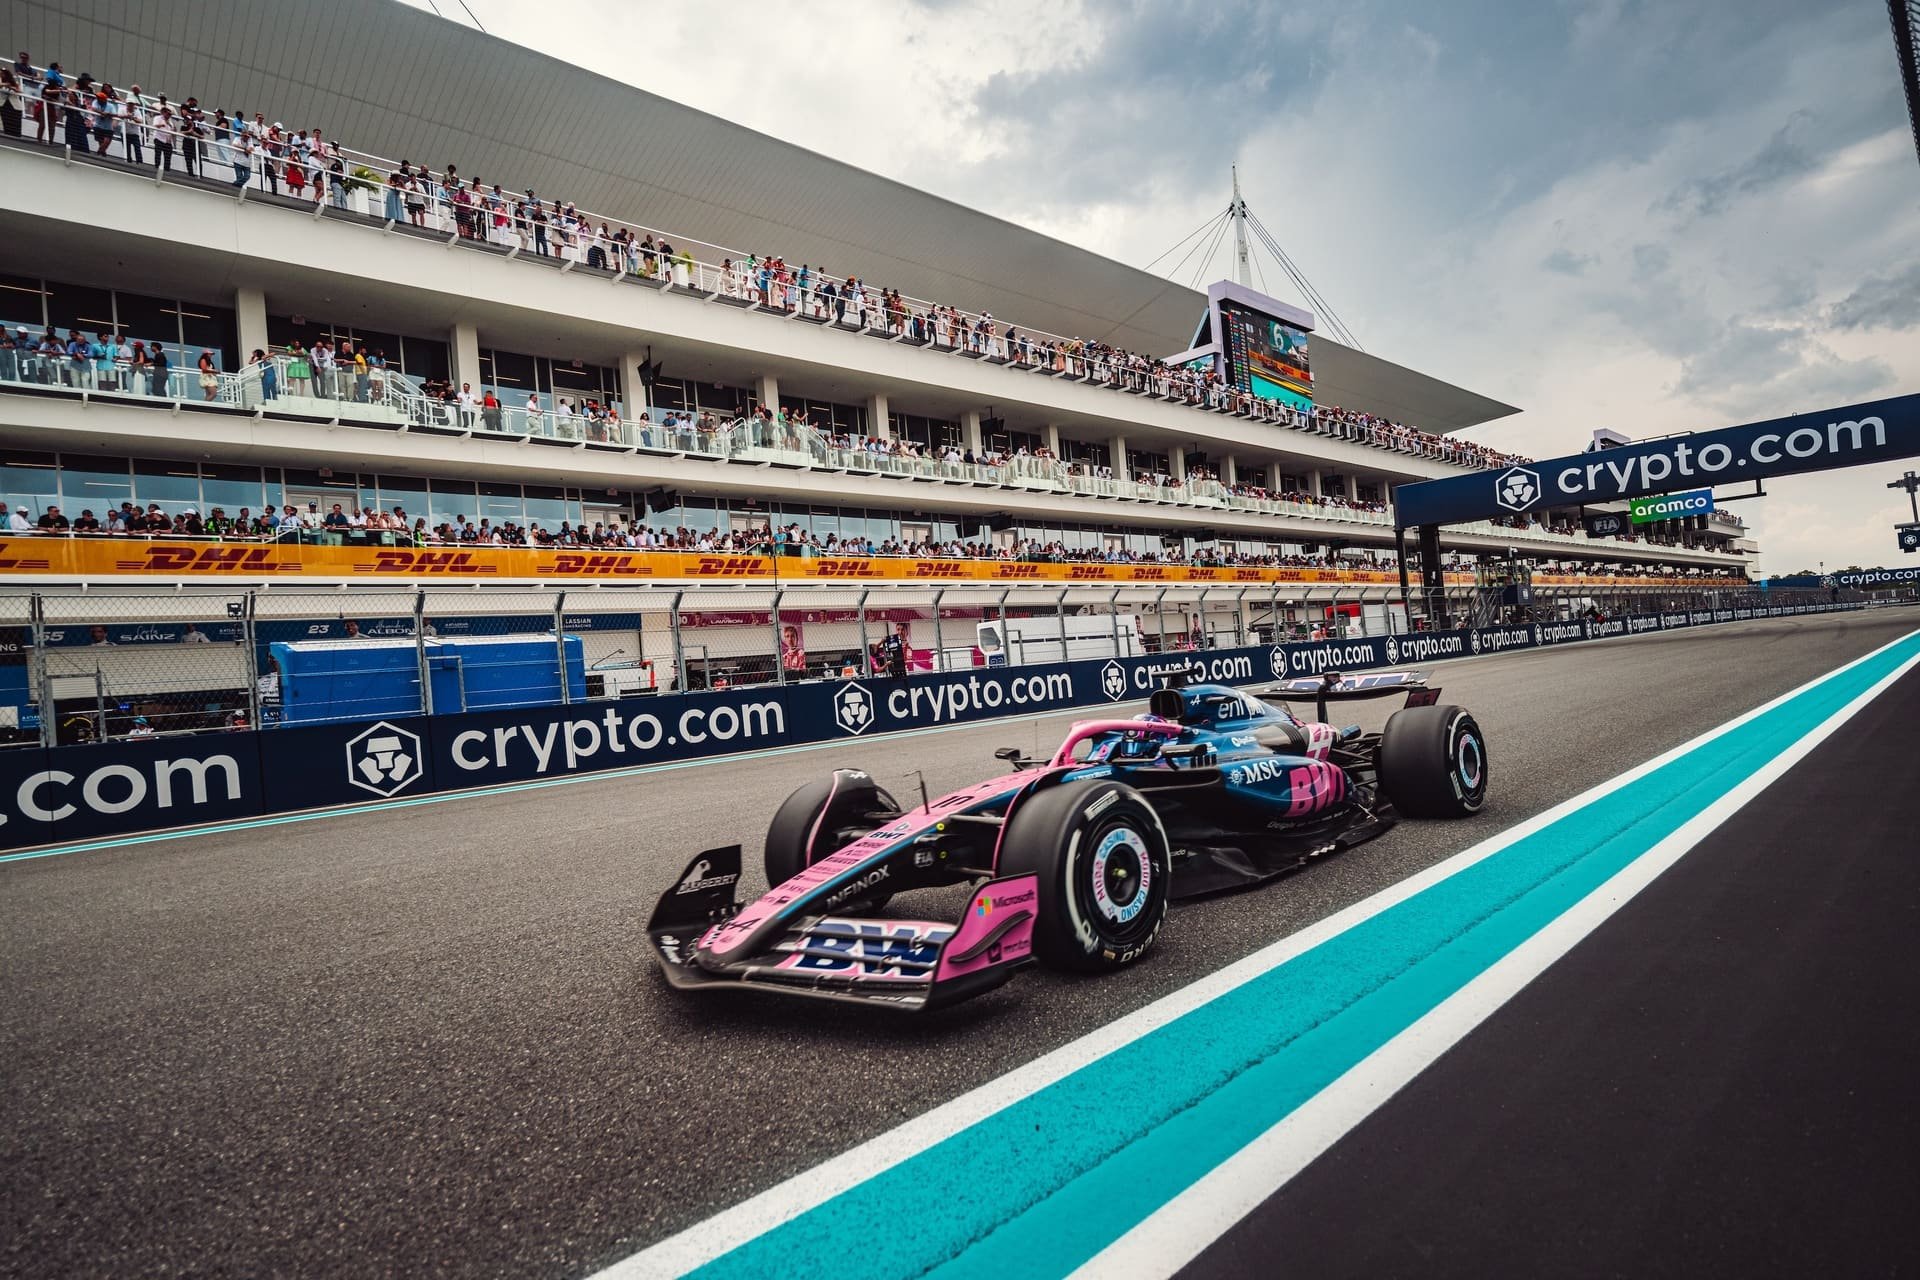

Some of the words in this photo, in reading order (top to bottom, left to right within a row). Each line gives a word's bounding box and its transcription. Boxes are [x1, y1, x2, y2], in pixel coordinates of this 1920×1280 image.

[1557, 414, 1886, 494] crypto.com
[1635, 497, 1707, 516] aramco
[144, 547, 279, 570] DHL
[374, 552, 479, 572] DHL
[553, 555, 638, 574] DHL
[698, 558, 766, 575] DHL
[816, 560, 875, 576] DHL
[915, 562, 964, 577] DHL
[999, 565, 1041, 578] DHL
[1071, 566, 1107, 579] DHL
[1133, 568, 1165, 579] DHL
[1188, 569, 1217, 580] DHL
[1236, 570, 1261, 580] DHL
[1279, 571, 1302, 581] DHL
[308, 624, 330, 634] 23
[1593, 620, 1623, 637] crypto.com
[1632, 616, 1658, 631] crypto.com
[120, 633, 176, 641] SAINZ
[1482, 629, 1528, 649] crypto.com
[1544, 624, 1581, 643] crypto.com
[1402, 636, 1462, 660] crypto.com
[1292, 643, 1374, 673] crypto.com
[888, 672, 1073, 721] crypto.com
[451, 701, 785, 772] crypto.com
[1241, 759, 1283, 785] MSC
[868, 831, 905, 839] BWT
[826, 864, 890, 905] INFINOX
[992, 889, 1035, 908] Microsoft
